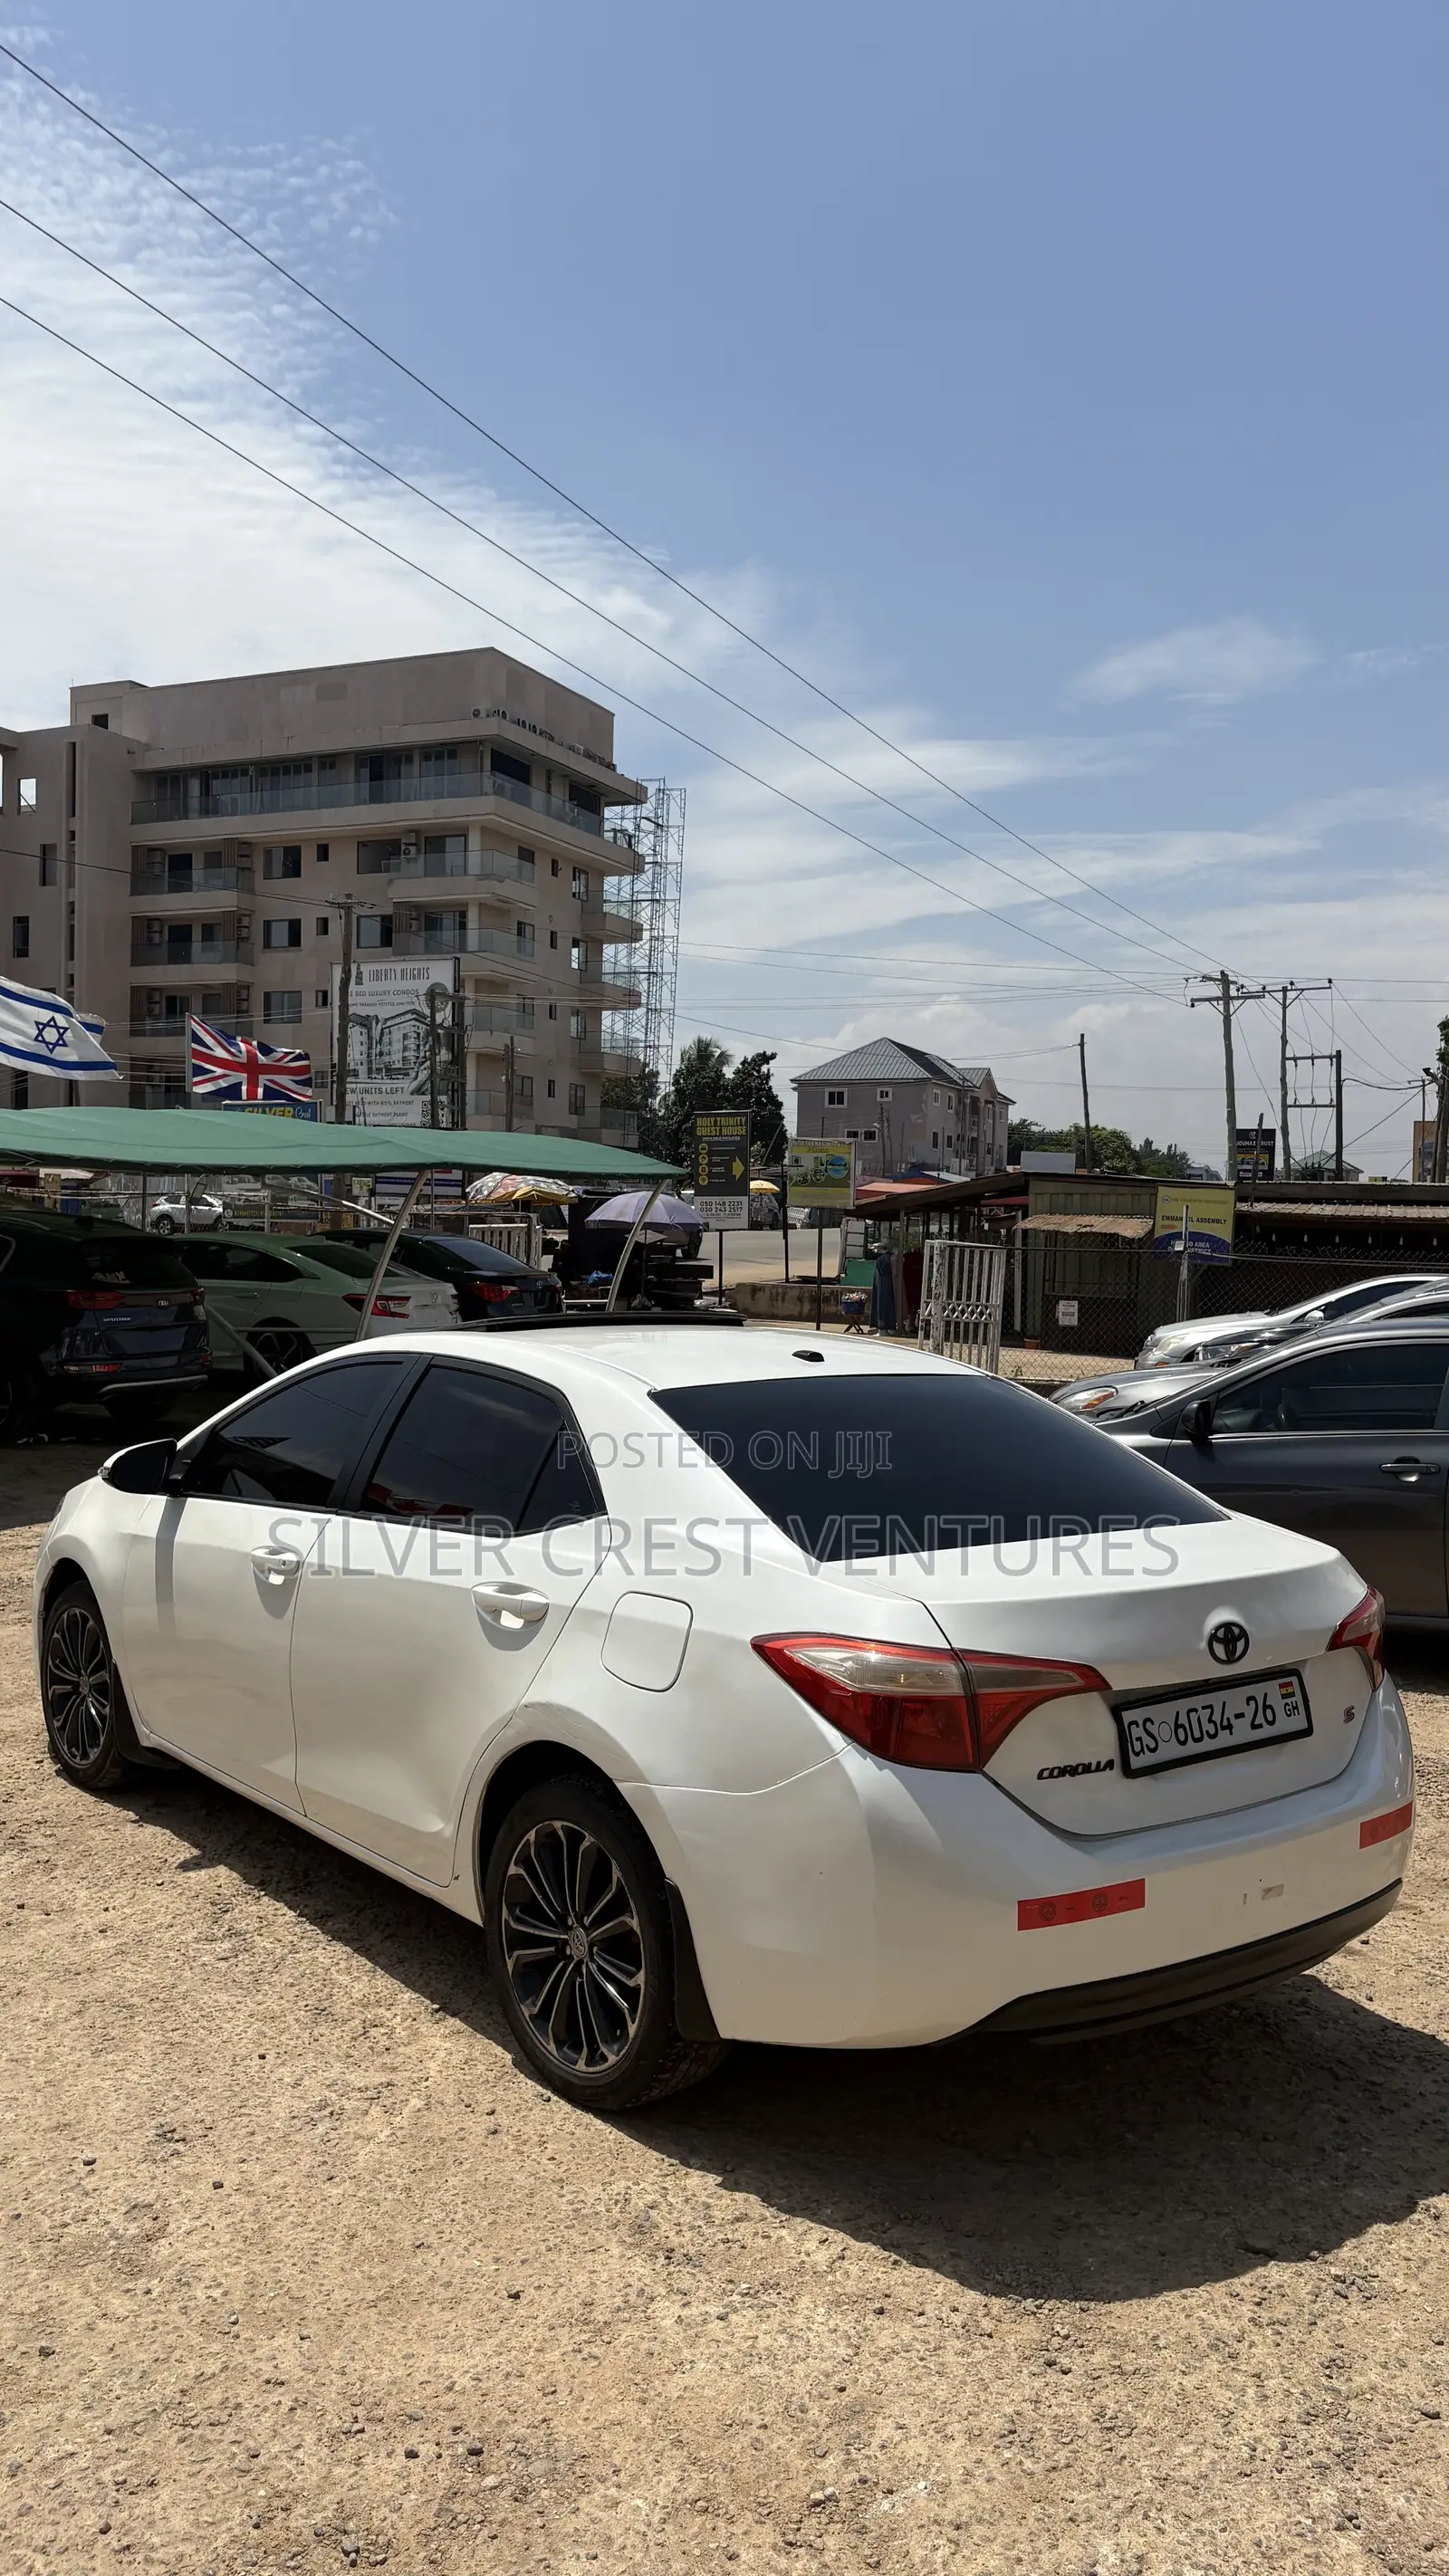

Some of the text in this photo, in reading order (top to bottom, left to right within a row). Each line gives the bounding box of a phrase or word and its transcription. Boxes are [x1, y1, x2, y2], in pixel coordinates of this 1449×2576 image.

[369, 966, 430, 982] LIBERTY HEIGHTS
[359, 1087, 383, 1095] UNITS
[385, 1087, 405, 1095] LEFT
[696, 1116, 746, 1127] HOLY TRINITY
[696, 1125, 747, 1136] GUEST HOUSE
[1195, 1217, 1227, 1225] ASSEMBLY
[1283, 1700, 1300, 1718] GH
[1127, 1691, 1277, 1757] GS 6034-26
[1036, 1758, 1115, 1781] COROLLA
